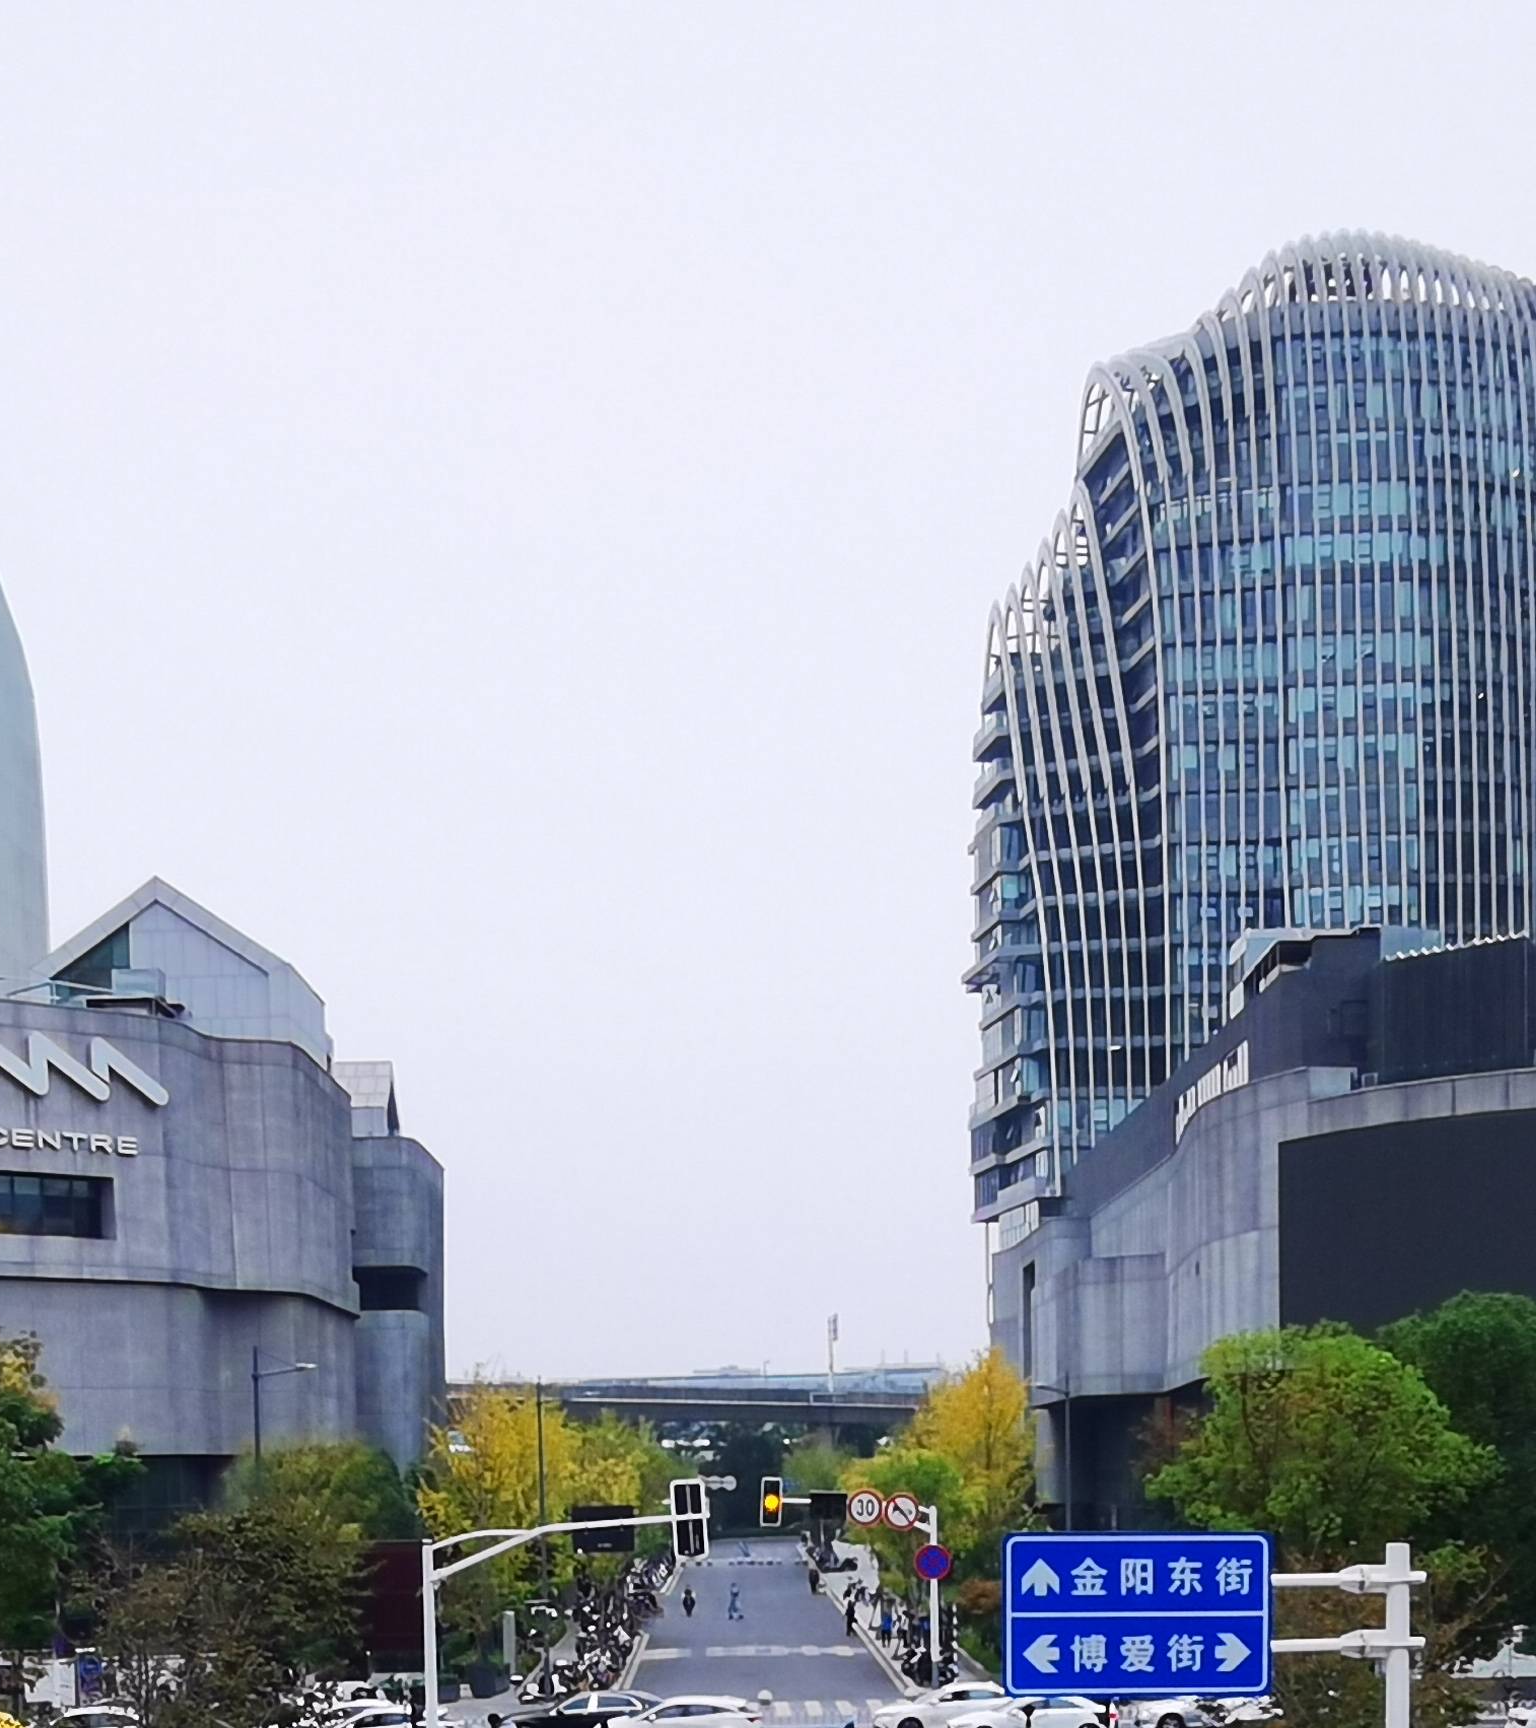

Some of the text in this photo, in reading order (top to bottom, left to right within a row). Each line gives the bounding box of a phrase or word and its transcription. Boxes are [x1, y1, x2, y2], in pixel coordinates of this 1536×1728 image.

[857, 1499, 876, 1517] 30
[1070, 1556, 1254, 1597] 金阳东街
[1070, 1634, 1204, 1673] 博爱街
